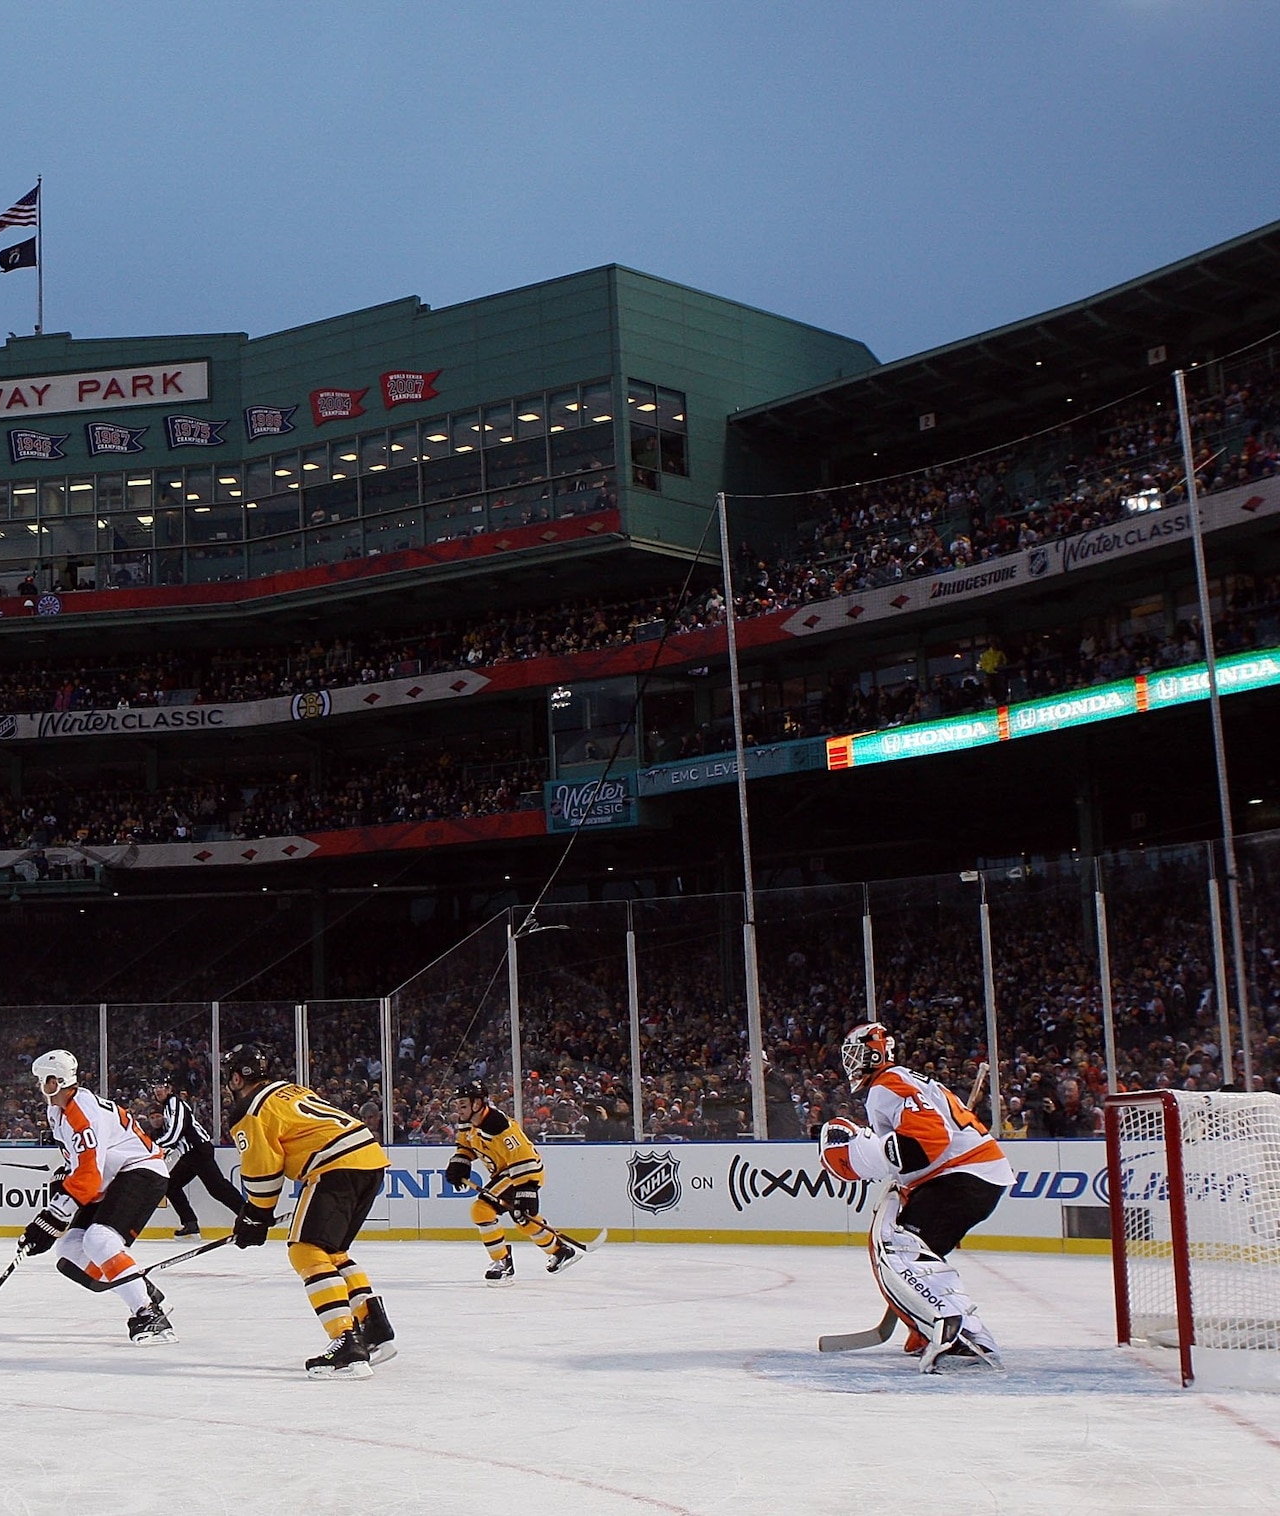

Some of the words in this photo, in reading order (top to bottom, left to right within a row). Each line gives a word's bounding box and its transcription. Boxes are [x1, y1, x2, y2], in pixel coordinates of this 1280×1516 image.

[78, 371, 184, 402] PARK
[387, 379, 424, 396] 2007
[318, 397, 352, 414] 2004
[174, 423, 211, 439] 1975
[251, 413, 283, 429] 1986
[16, 437, 52, 453] 1946
[94, 430, 130, 447] 1967
[930, 564, 1017, 599] BRIDGESTONE
[1055, 529, 1123, 572] Winter
[1124, 511, 1203, 546] CLASSI
[1038, 691, 1124, 720] HONDA
[30, 710, 122, 738] Winter
[122, 709, 223, 730] CLASSIC
[902, 721, 989, 748] HONDA
[671, 769, 699, 784] EMC
[705, 761, 748, 778] LEVE
[556, 779, 626, 820] Winter
[72, 1127, 98, 1153] 20
[235, 1131, 250, 1152] 6
[504, 1135, 521, 1151] 91
[638, 1168, 671, 1200] NHL
[691, 1176, 713, 1189] ON
[761, 1169, 835, 1198] XM
[1009, 1170, 1088, 1199] UD
[900, 1269, 946, 1311] Reebok
